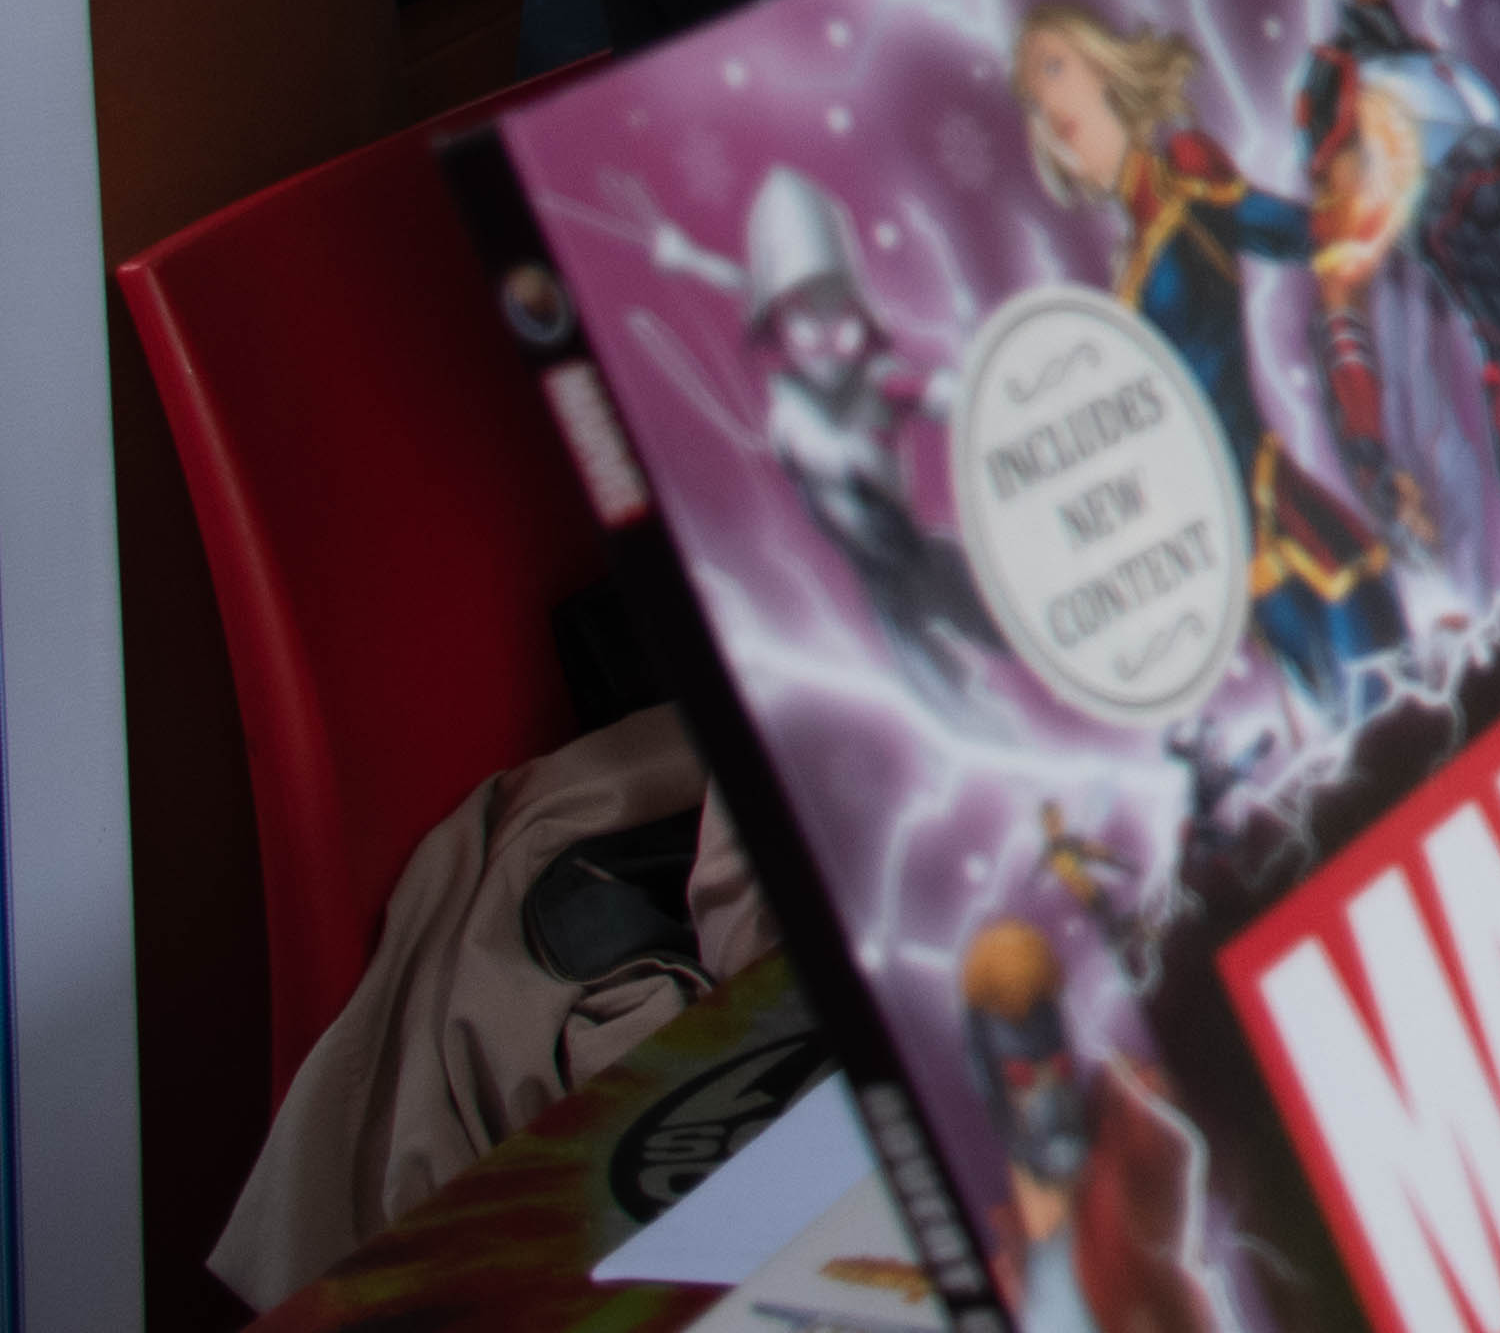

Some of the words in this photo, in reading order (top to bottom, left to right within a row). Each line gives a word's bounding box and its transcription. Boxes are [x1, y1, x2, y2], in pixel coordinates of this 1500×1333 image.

[986, 375, 1166, 501] INCLUDES
[1060, 467, 1146, 551] NEW
[1048, 519, 1216, 649] CONTENT
